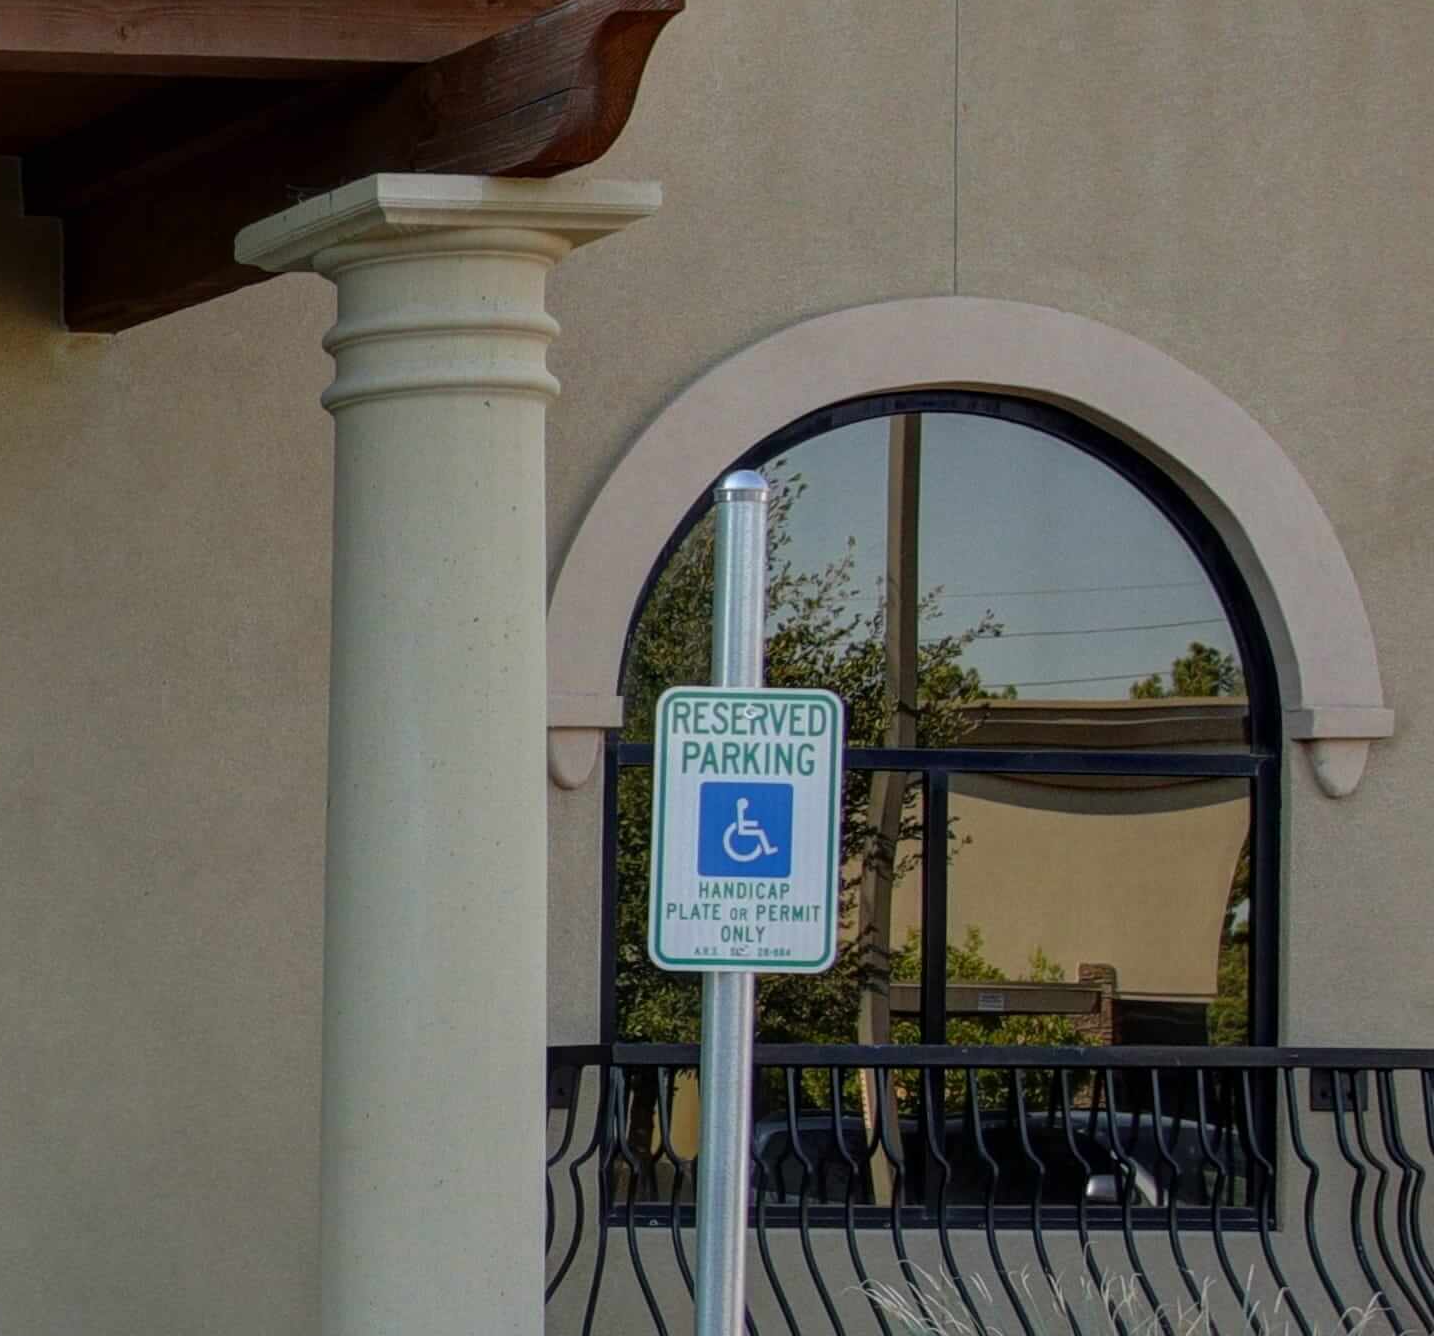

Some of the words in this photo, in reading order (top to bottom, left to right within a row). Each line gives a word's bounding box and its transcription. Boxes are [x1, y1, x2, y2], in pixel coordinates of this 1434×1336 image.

[672, 701, 826, 737] RESERVED
[682, 741, 815, 776] PARKING
[699, 881, 791, 900] HANDICAP
[666, 903, 721, 920] PLATE
[730, 908, 747, 921] OR
[756, 905, 820, 922] PERMIT
[721, 926, 766, 943] ONLY
